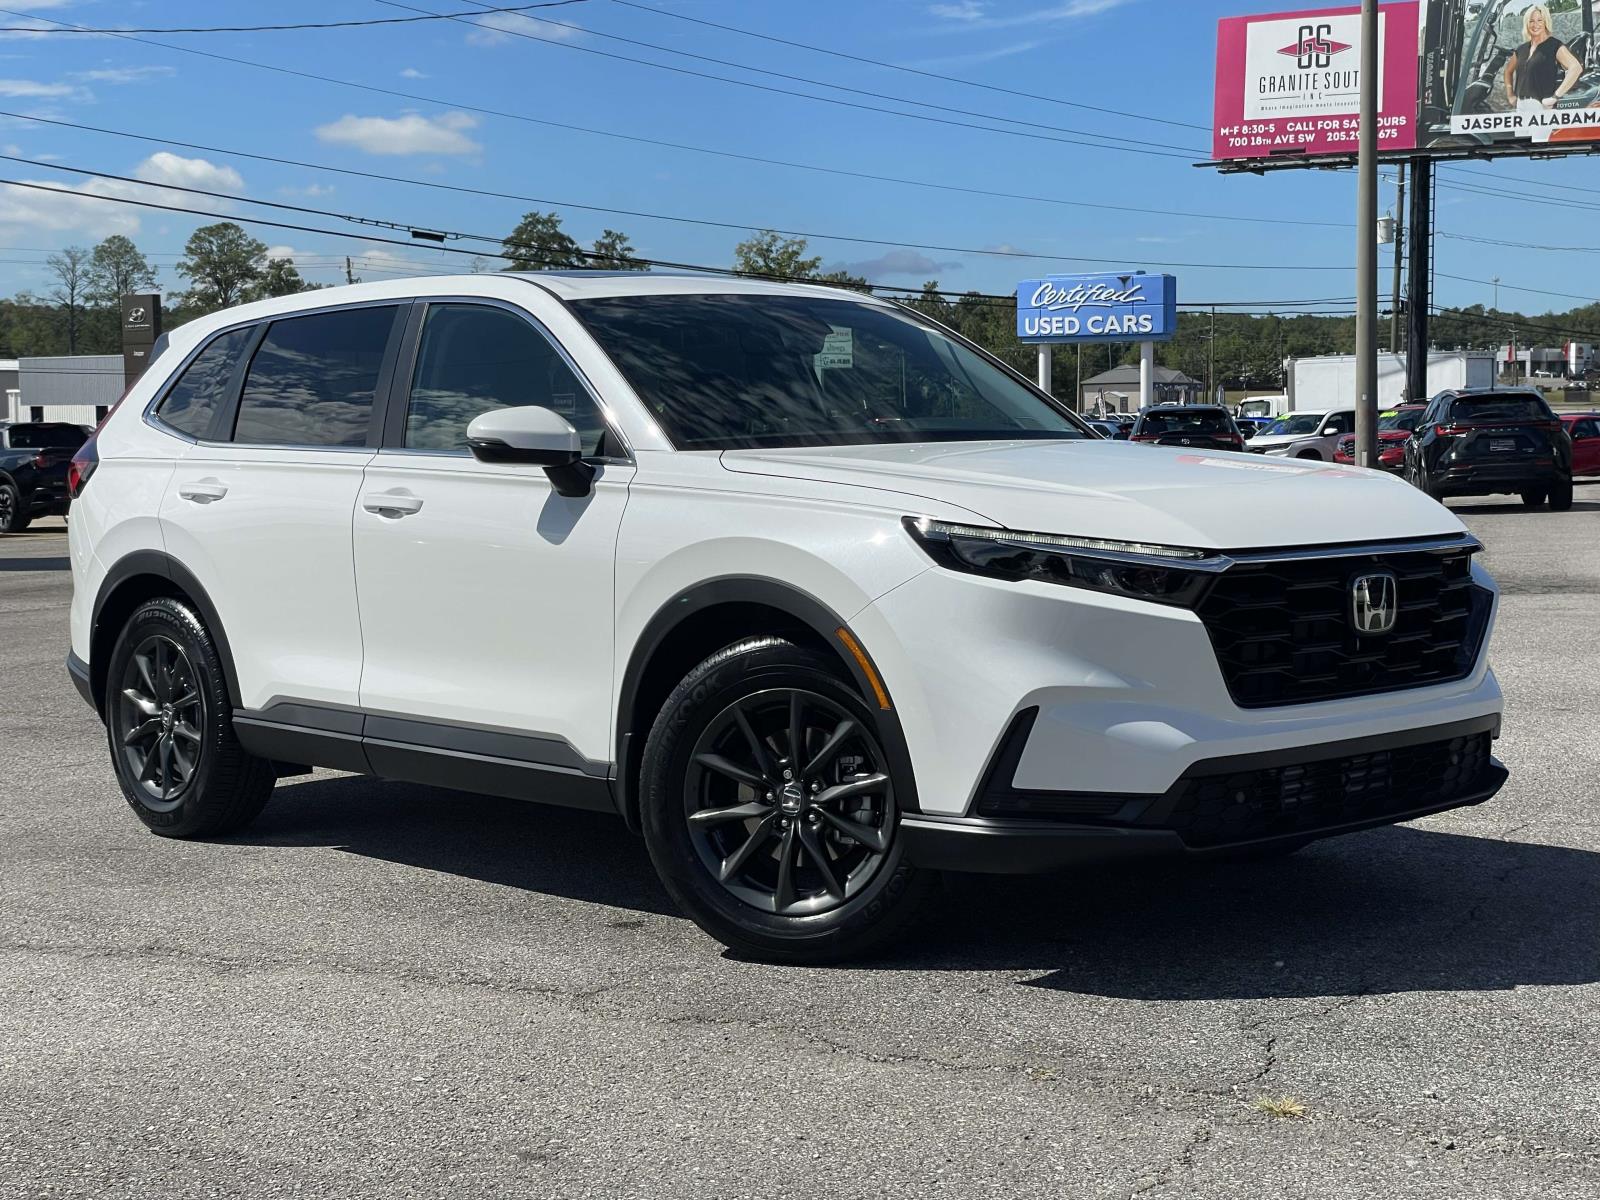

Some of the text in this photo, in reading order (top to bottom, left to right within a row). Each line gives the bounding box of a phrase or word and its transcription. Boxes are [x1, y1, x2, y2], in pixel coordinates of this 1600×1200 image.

[1259, 70, 1360, 93] GRANITE SOUT
[1303, 92, 1322, 100] INC
[1220, 125, 1239, 136] M-F
[1242, 124, 1275, 134] 8:30-5
[1287, 121, 1314, 131] CALL
[1318, 120, 1340, 130] FOR
[1377, 116, 1407, 127] OURS
[1461, 116, 1523, 130] JASPER
[1228, 137, 1248, 147] 700
[1274, 134, 1295, 145] AVE
[1297, 133, 1315, 143] SW
[1031, 282, 1146, 313] Certified
[1025, 314, 1153, 335] USED CARS
